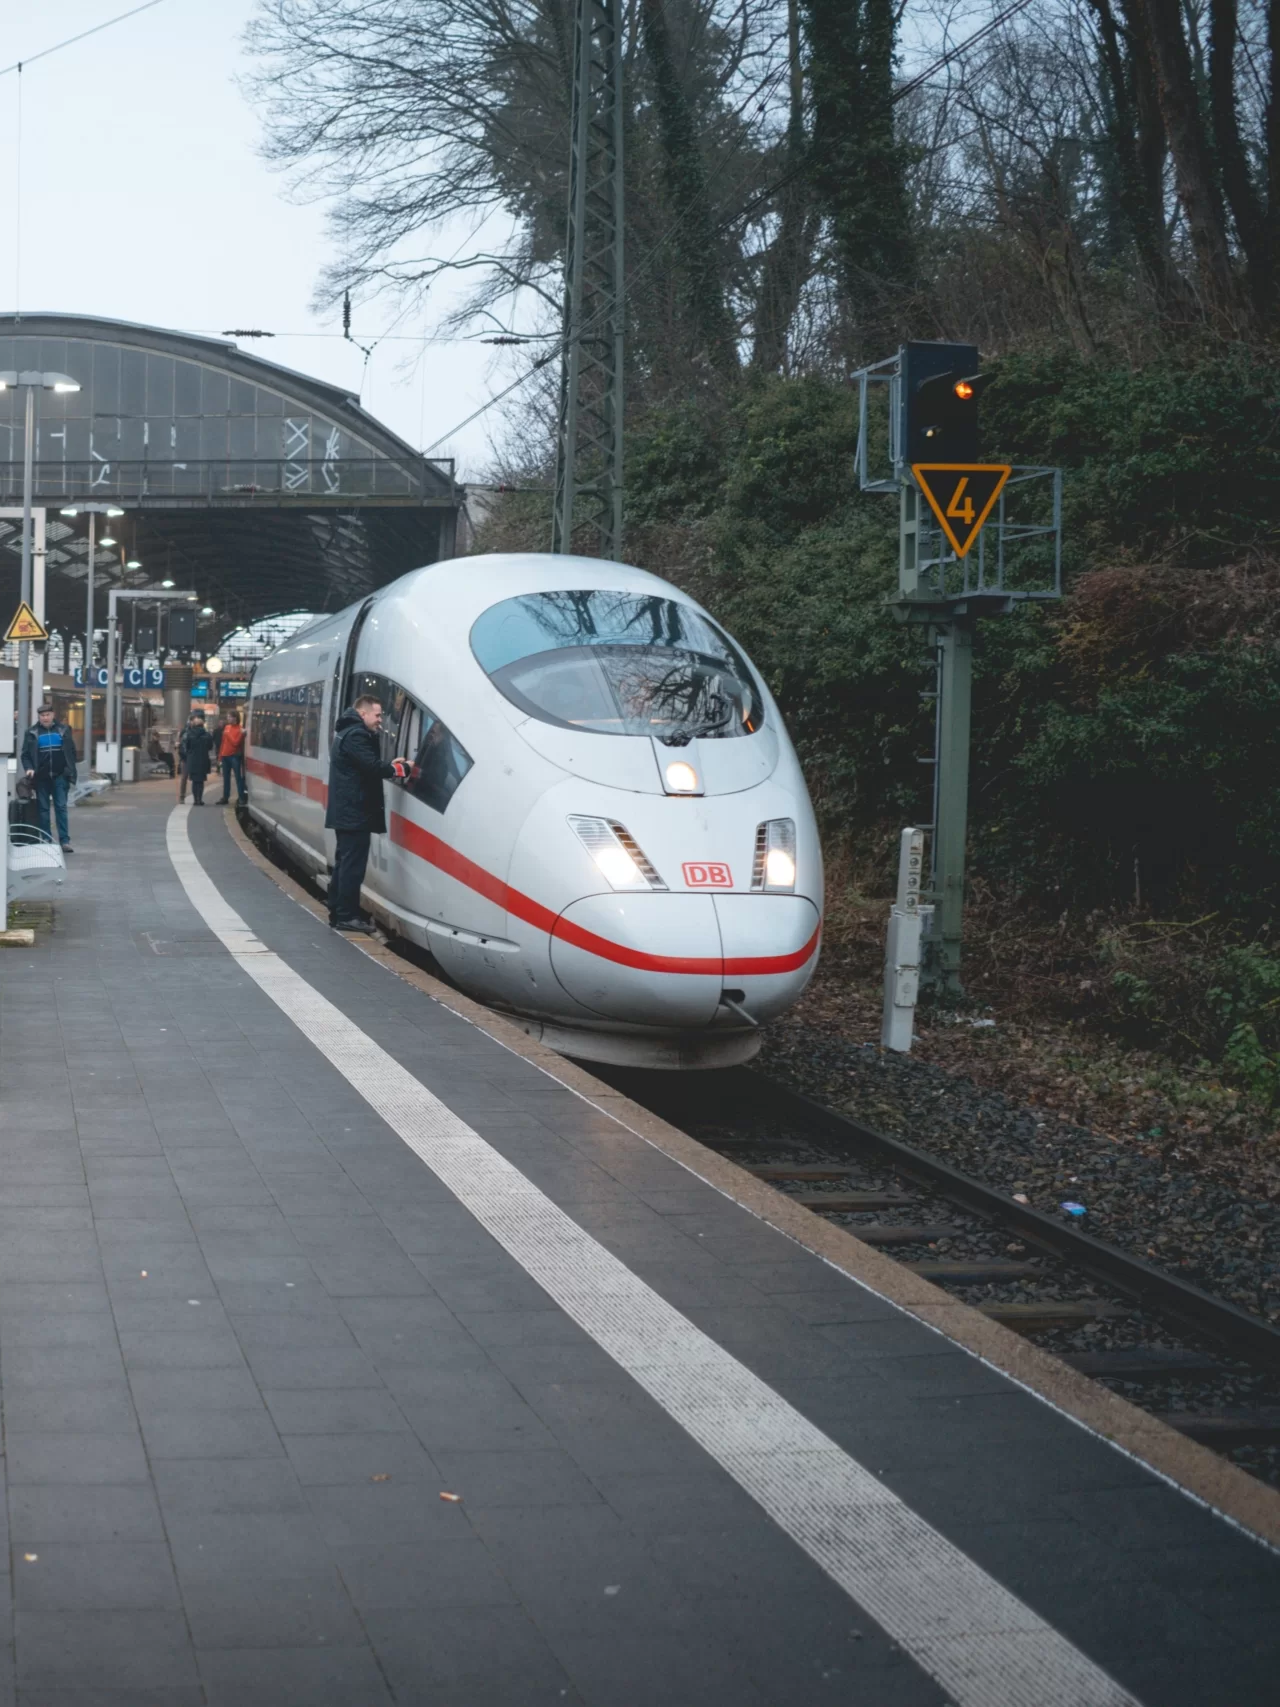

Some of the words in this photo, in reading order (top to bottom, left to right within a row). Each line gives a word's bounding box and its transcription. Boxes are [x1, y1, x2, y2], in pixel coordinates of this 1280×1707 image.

[946, 477, 976, 524] 4
[129, 669, 142, 685] C
[152, 669, 164, 685] 9
[687, 865, 728, 884] DB
